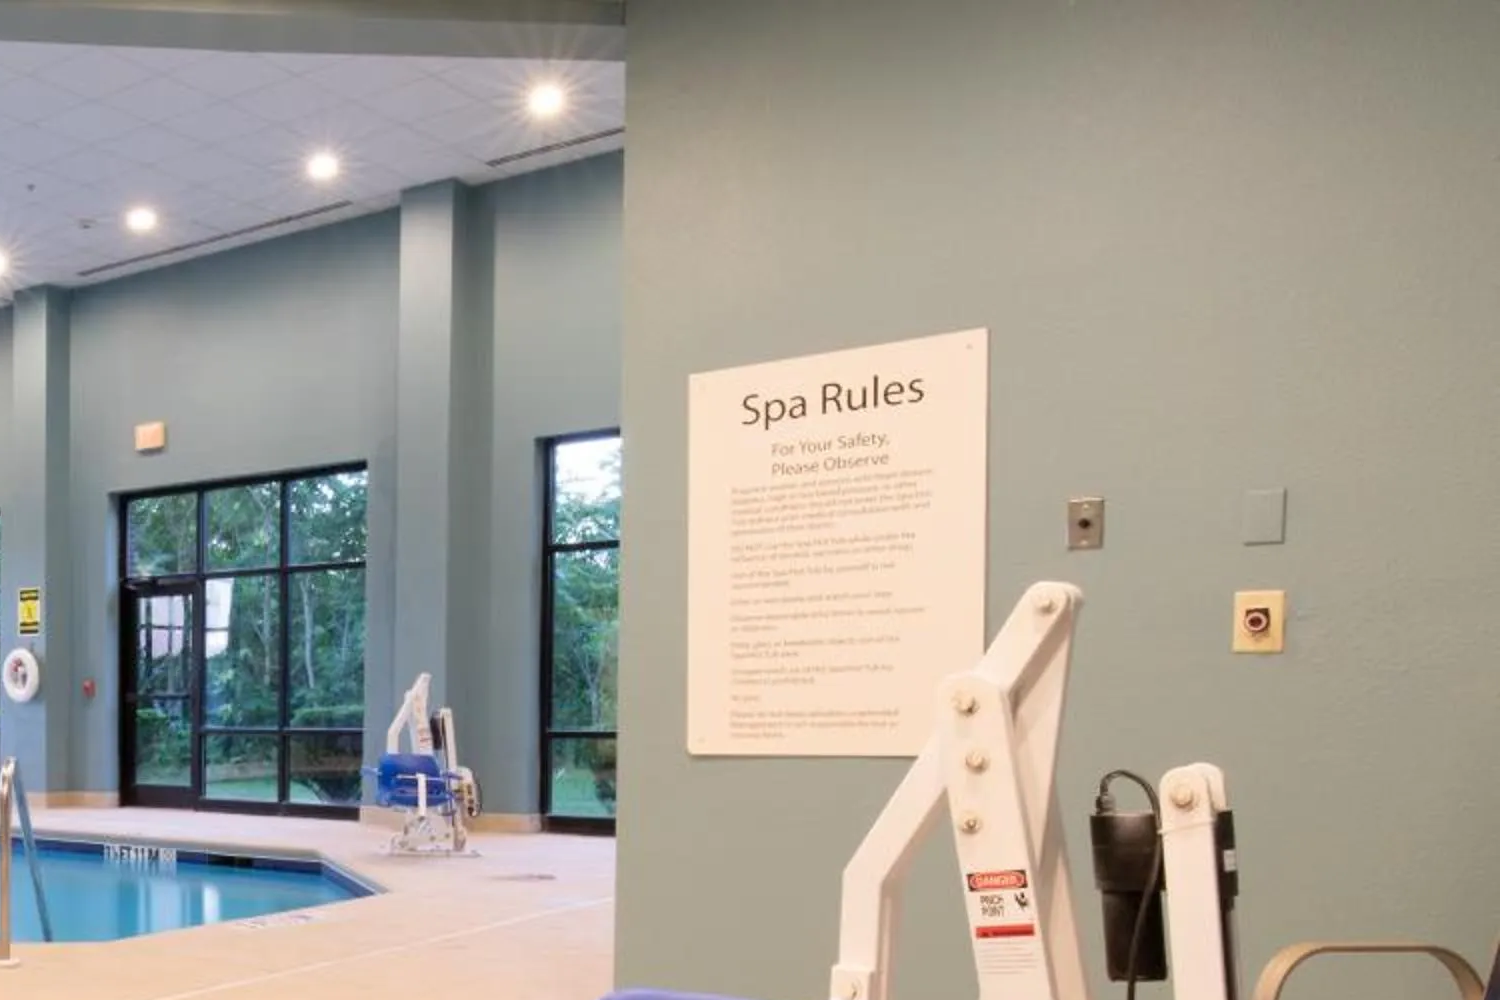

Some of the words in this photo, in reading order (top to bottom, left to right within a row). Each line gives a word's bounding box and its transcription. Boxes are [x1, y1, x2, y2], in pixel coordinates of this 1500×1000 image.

[742, 394, 807, 430] Spa
[822, 375, 925, 414] Rules
[771, 442, 795, 457] For
[799, 440, 832, 456] Your
[771, 460, 819, 476] Please
[823, 453, 889, 471] Observe
